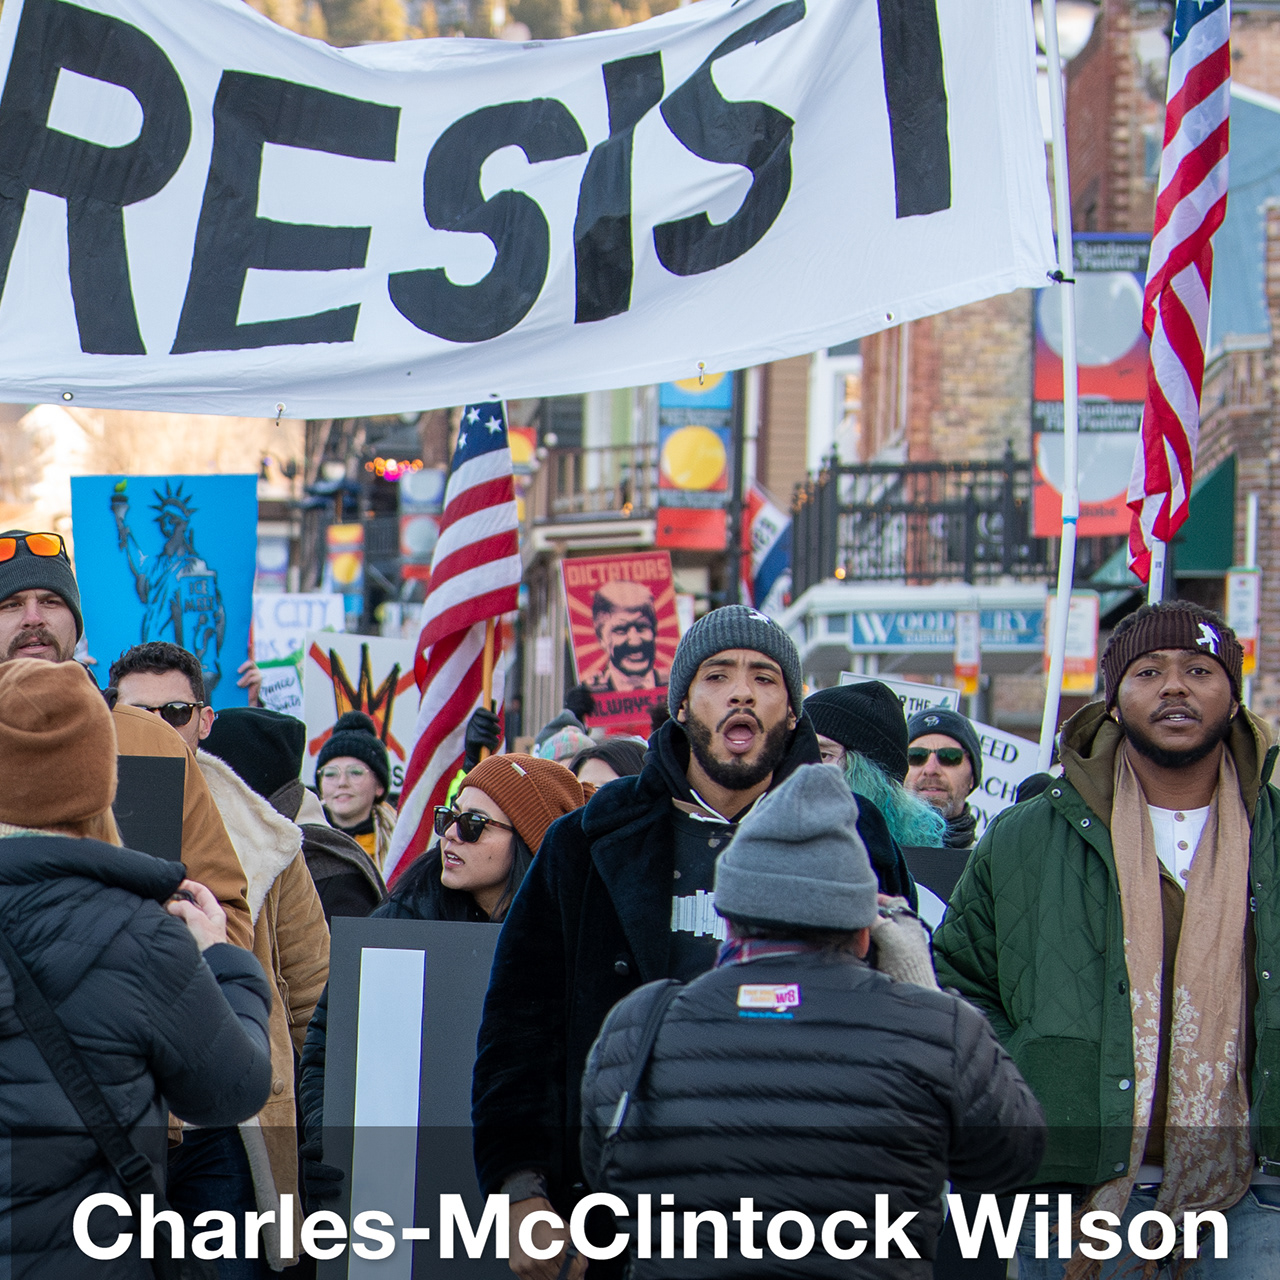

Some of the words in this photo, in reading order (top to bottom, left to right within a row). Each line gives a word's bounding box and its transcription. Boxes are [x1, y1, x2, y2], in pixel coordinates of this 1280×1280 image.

[566, 558, 669, 586] DICTATORS
[189, 579, 209, 595] ICE
[274, 599, 329, 628] CITY
[981, 734, 1020, 764] EED
